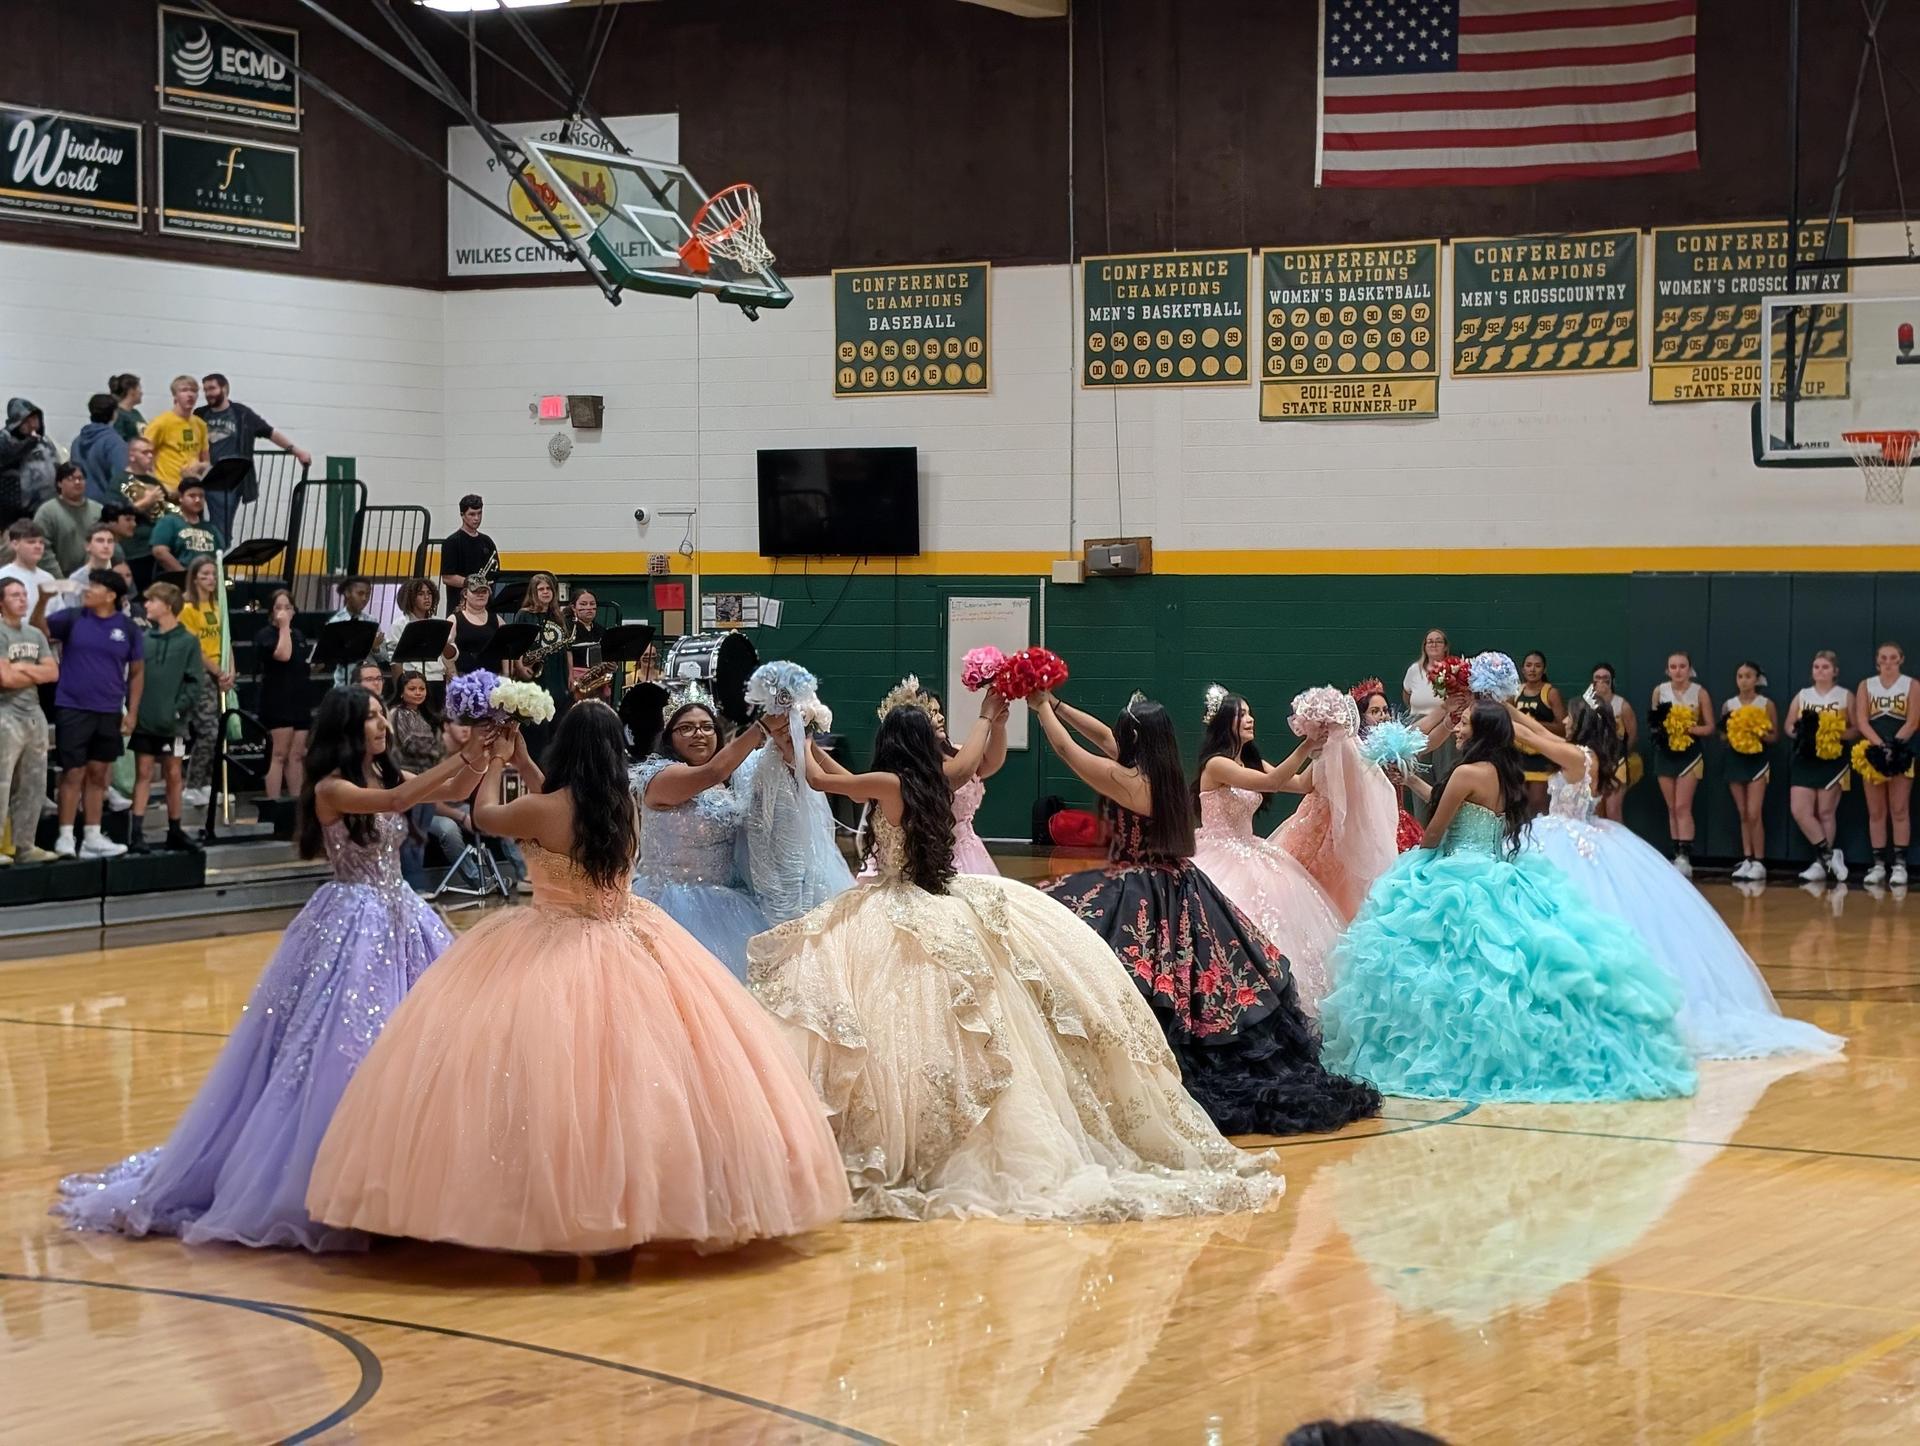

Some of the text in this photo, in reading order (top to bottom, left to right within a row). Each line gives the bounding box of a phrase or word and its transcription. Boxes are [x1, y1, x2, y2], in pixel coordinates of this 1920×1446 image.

[221, 46, 285, 80] ECMD
[197, 188, 264, 205] FINLEY
[456, 247, 511, 264] WILKES
[1285, 249, 1416, 270] CONFERENCE
[1475, 241, 1615, 264] CONFERENCE
[1694, 253, 1816, 271] CHAMPIOS
[1102, 261, 1228, 280] CONFERENCE
[1300, 267, 1408, 285] CHAMPIONS
[1491, 264, 1606, 282] CHAMPIONS
[853, 273, 969, 293] CONFERENCE
[1117, 282, 1220, 298] CHAMPIONS
[1659, 279, 1725, 295] WOMEN'S
[867, 294, 962, 310] CHAMPIONS
[1270, 284, 1431, 304] WOMEN'S BASKETBALL
[1461, 284, 1626, 307] MEN'S CROSSCOUNTRY
[1090, 302, 1241, 321] MEN'S BASKETBALL
[1272, 315, 1282, 324] 76
[1296, 314, 1305, 323] 77
[1344, 312, 1354, 322] 87
[1367, 311, 1378, 320] 90
[1415, 309, 1425, 318] 97
[1825, 306, 1835, 317] 01
[869, 314, 956, 330] BASEBALL
[1463, 317, 1627, 334] 90 92 94 96 97 07 08
[1093, 333, 1238, 347] 72 84 86 91 93 99
[1272, 332, 1425, 346] 98 00 01 03 05 06 12
[1664, 340, 1676, 350] 03
[1744, 338, 1755, 348] 07
[842, 342, 978, 357] 92 94 96 98 99 08 10
[1464, 352, 1474, 362] 21
[1093, 363, 1168, 375] 00 01 17 19
[1272, 358, 1327, 369] 15 19 20
[844, 370, 937, 383] 11 12 13 14 16
[1692, 367, 1771, 382] 2005-200
[1301, 385, 1365, 399] 2011-2012
[1674, 384, 1725, 398] STATE
[1282, 399, 1416, 414] STATE RUNNER-UP
